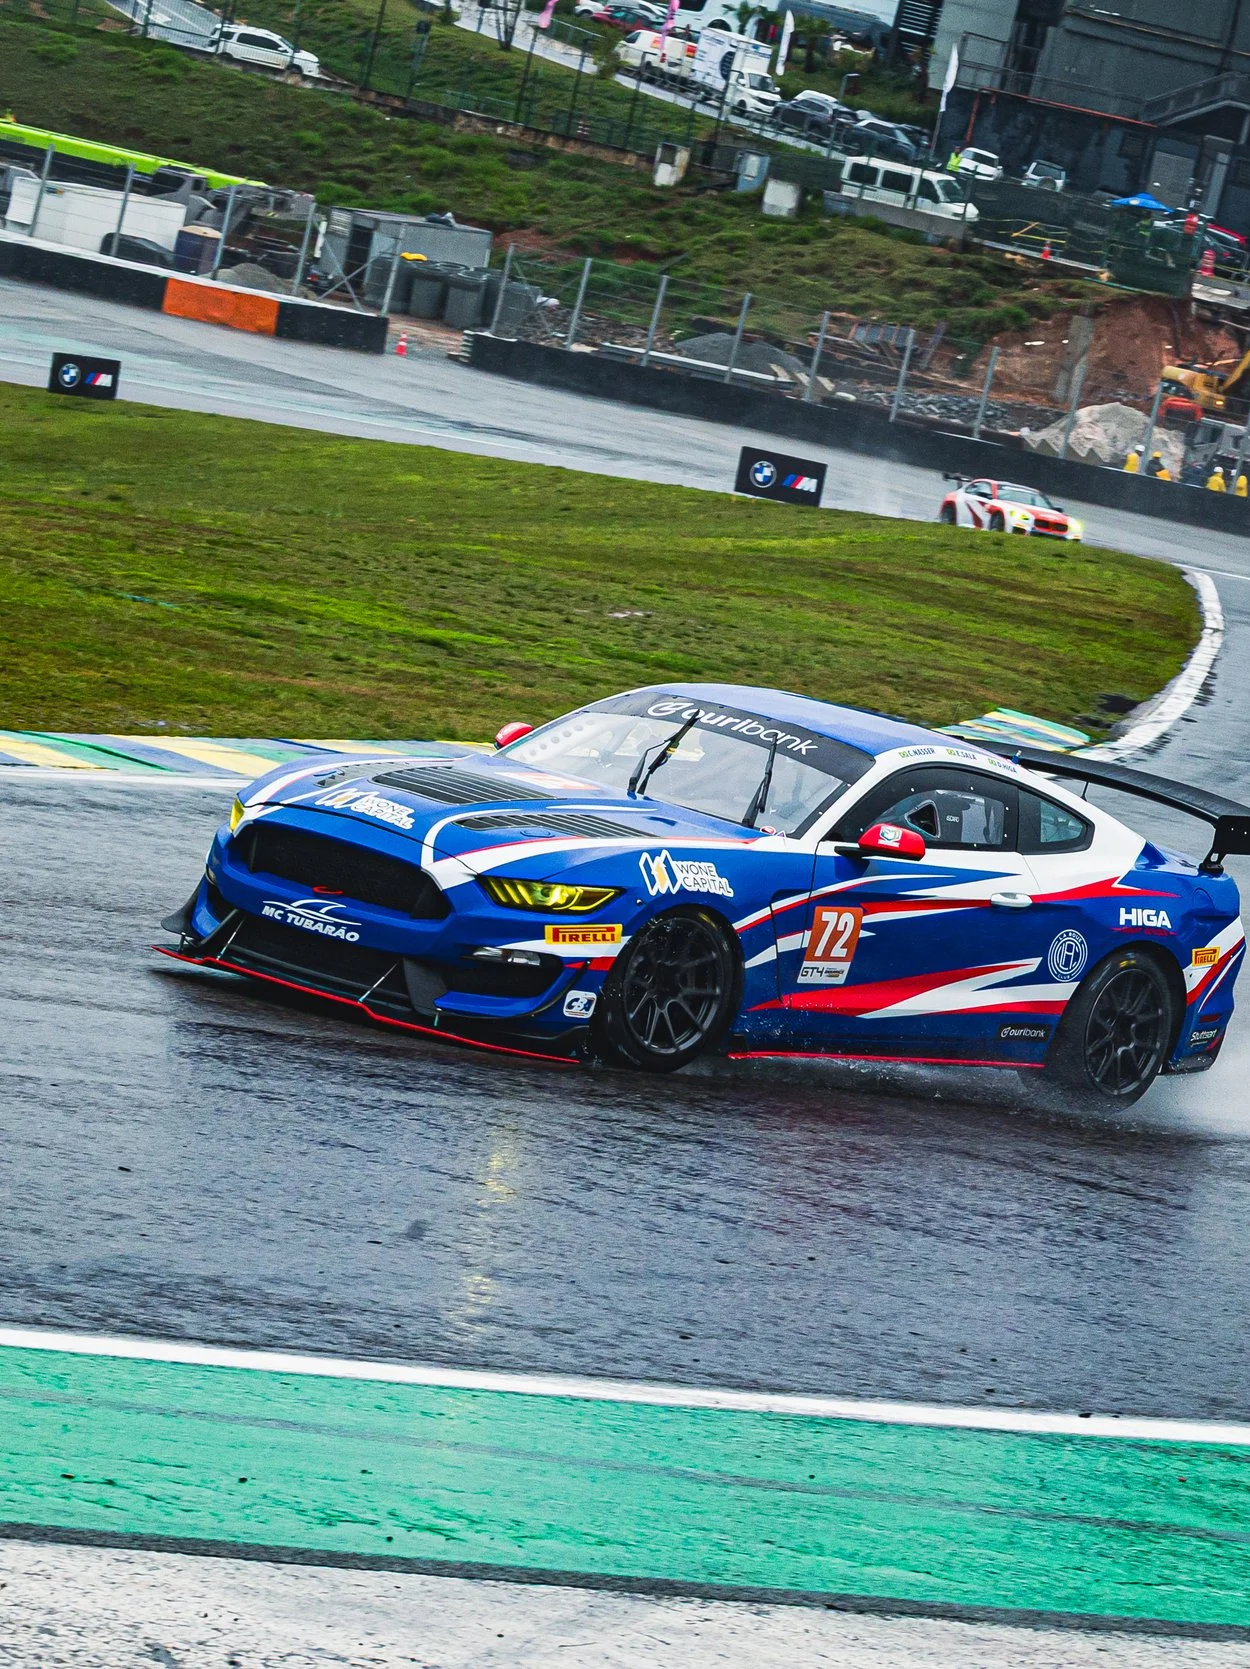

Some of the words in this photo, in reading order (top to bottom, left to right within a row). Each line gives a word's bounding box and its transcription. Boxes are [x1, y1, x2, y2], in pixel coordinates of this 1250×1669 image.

[681, 707, 818, 755] ouribank
[675, 863, 716, 877] WONE
[682, 876, 732, 894] CAPITAL
[261, 905, 284, 920] MC
[286, 913, 360, 942] TUBARÃO
[1119, 907, 1172, 929] HIGA
[552, 926, 616, 943] PIRELLI
[813, 911, 855, 958] 72
[1194, 948, 1217, 964] PIRELLI
[801, 966, 825, 978] GT4
